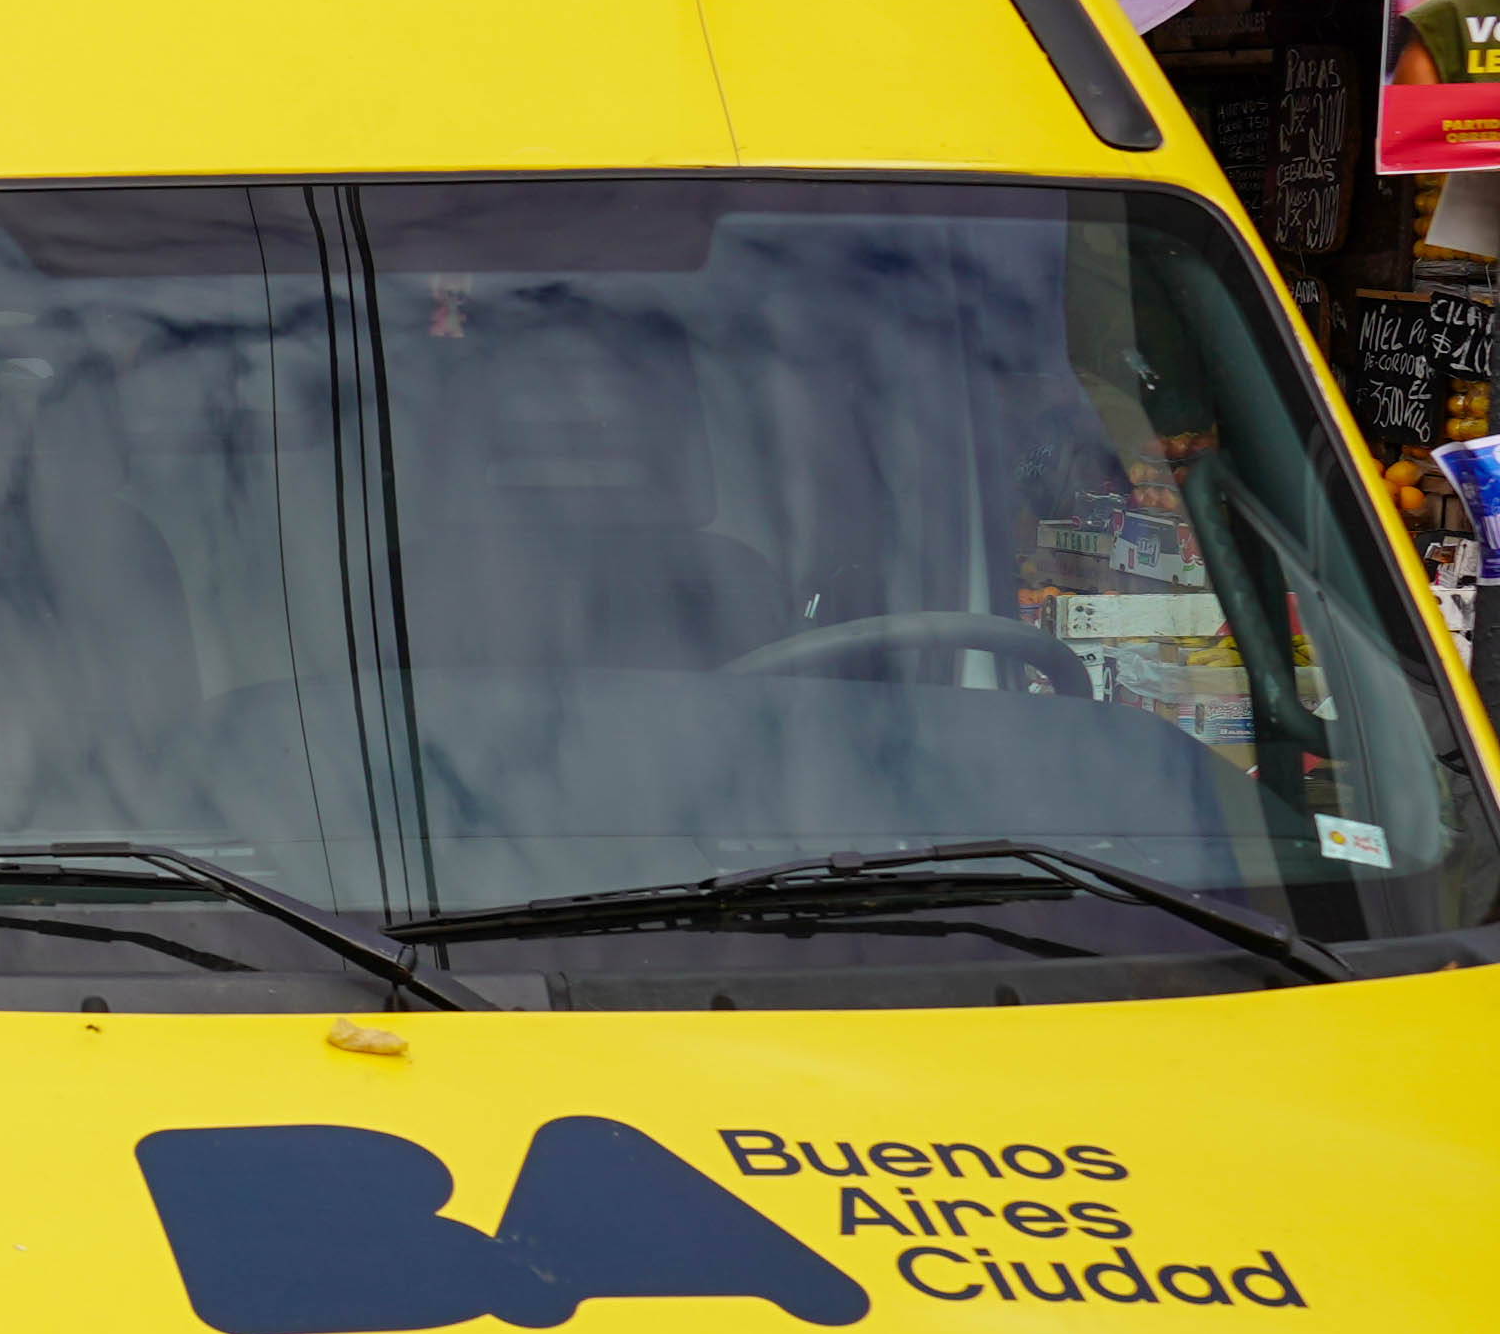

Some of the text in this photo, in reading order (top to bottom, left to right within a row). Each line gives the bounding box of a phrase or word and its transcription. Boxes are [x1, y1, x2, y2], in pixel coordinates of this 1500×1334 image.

[1285, 49, 1341, 91] PAPAS
[1359, 304, 1403, 351] MIEL
[1408, 379, 1432, 399] EL
[718, 1129, 1130, 1181] Buenos
[838, 1186, 1134, 1241] Aires
[895, 1245, 1310, 1308] Ciudad
